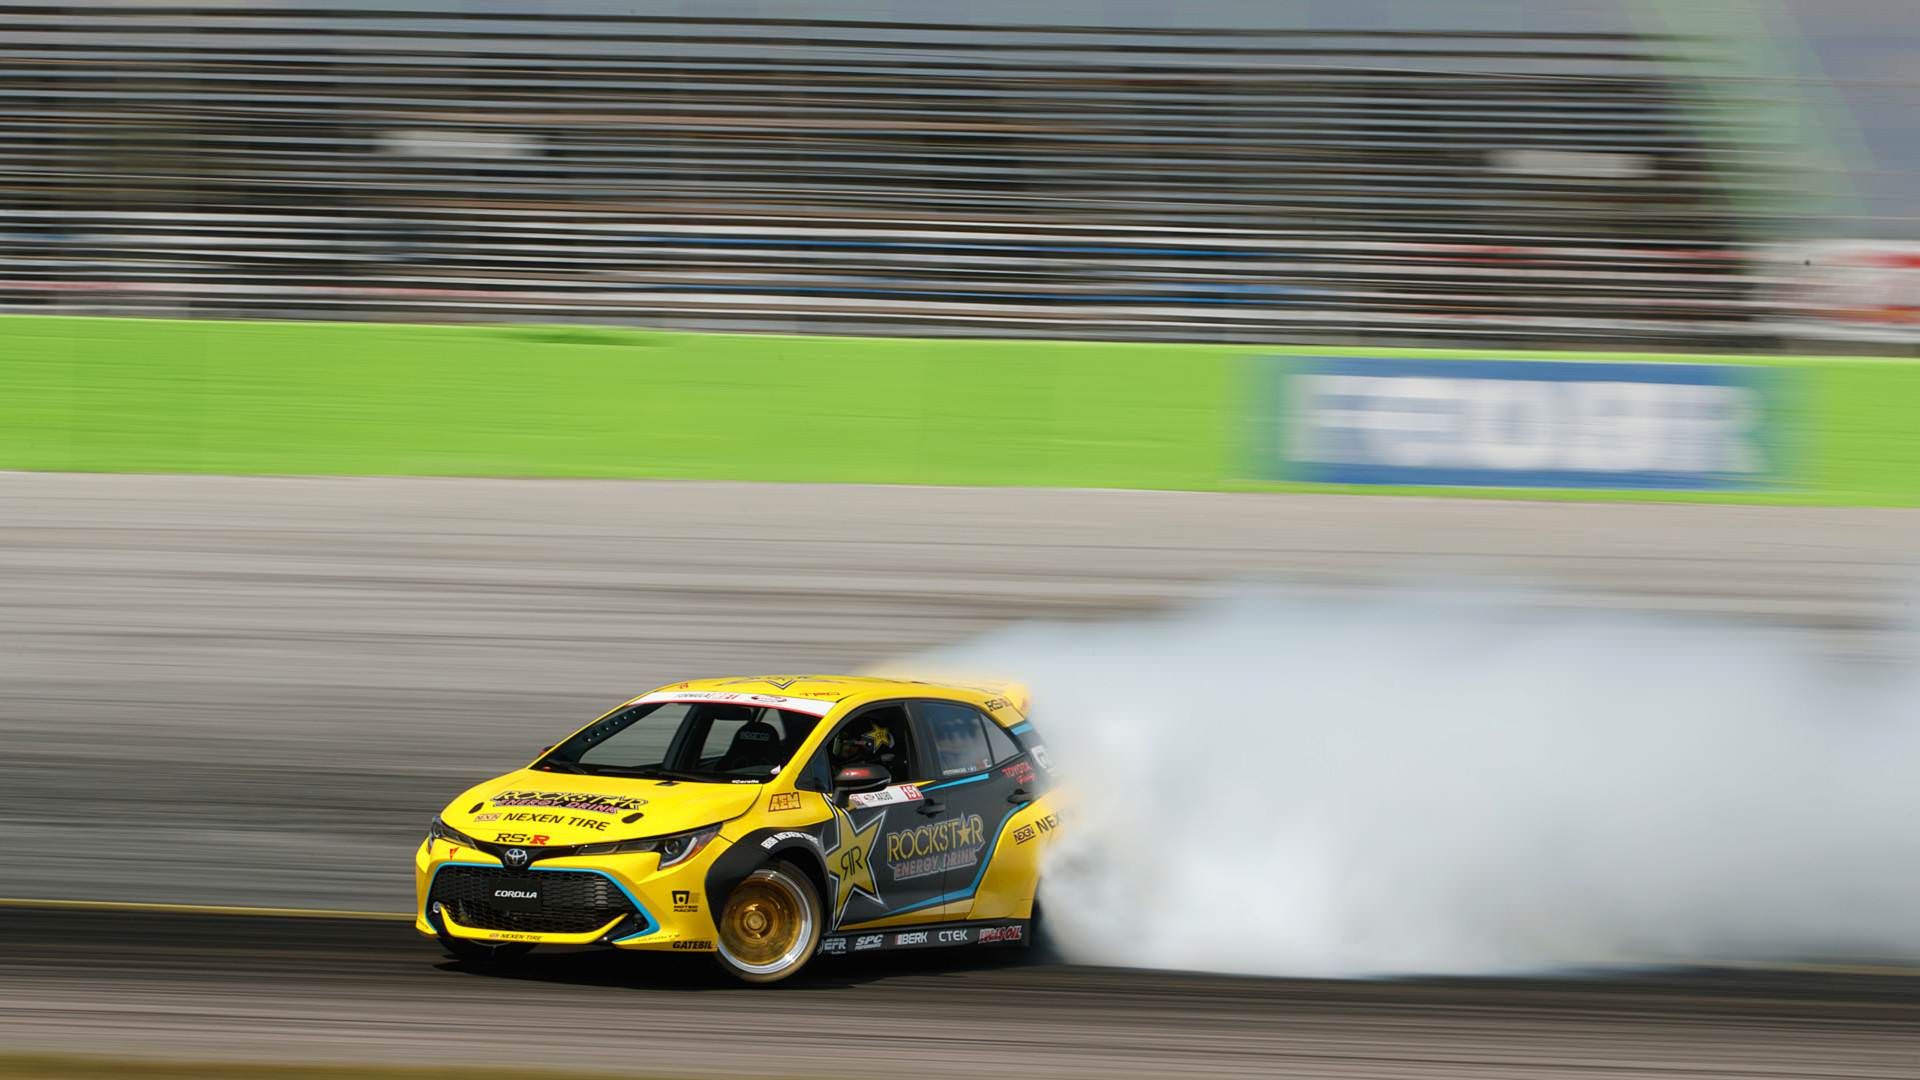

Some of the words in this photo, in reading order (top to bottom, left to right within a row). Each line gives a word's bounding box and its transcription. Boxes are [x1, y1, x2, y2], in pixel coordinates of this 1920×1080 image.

[503, 813, 563, 824] NEXEN
[567, 816, 611, 832] TIRE
[895, 856, 939, 876] ENERGY
[943, 848, 977, 868] DRINK
[495, 890, 538, 898] COROLLA
[856, 934, 883, 946] SPC
[938, 930, 968, 942] CTEK
